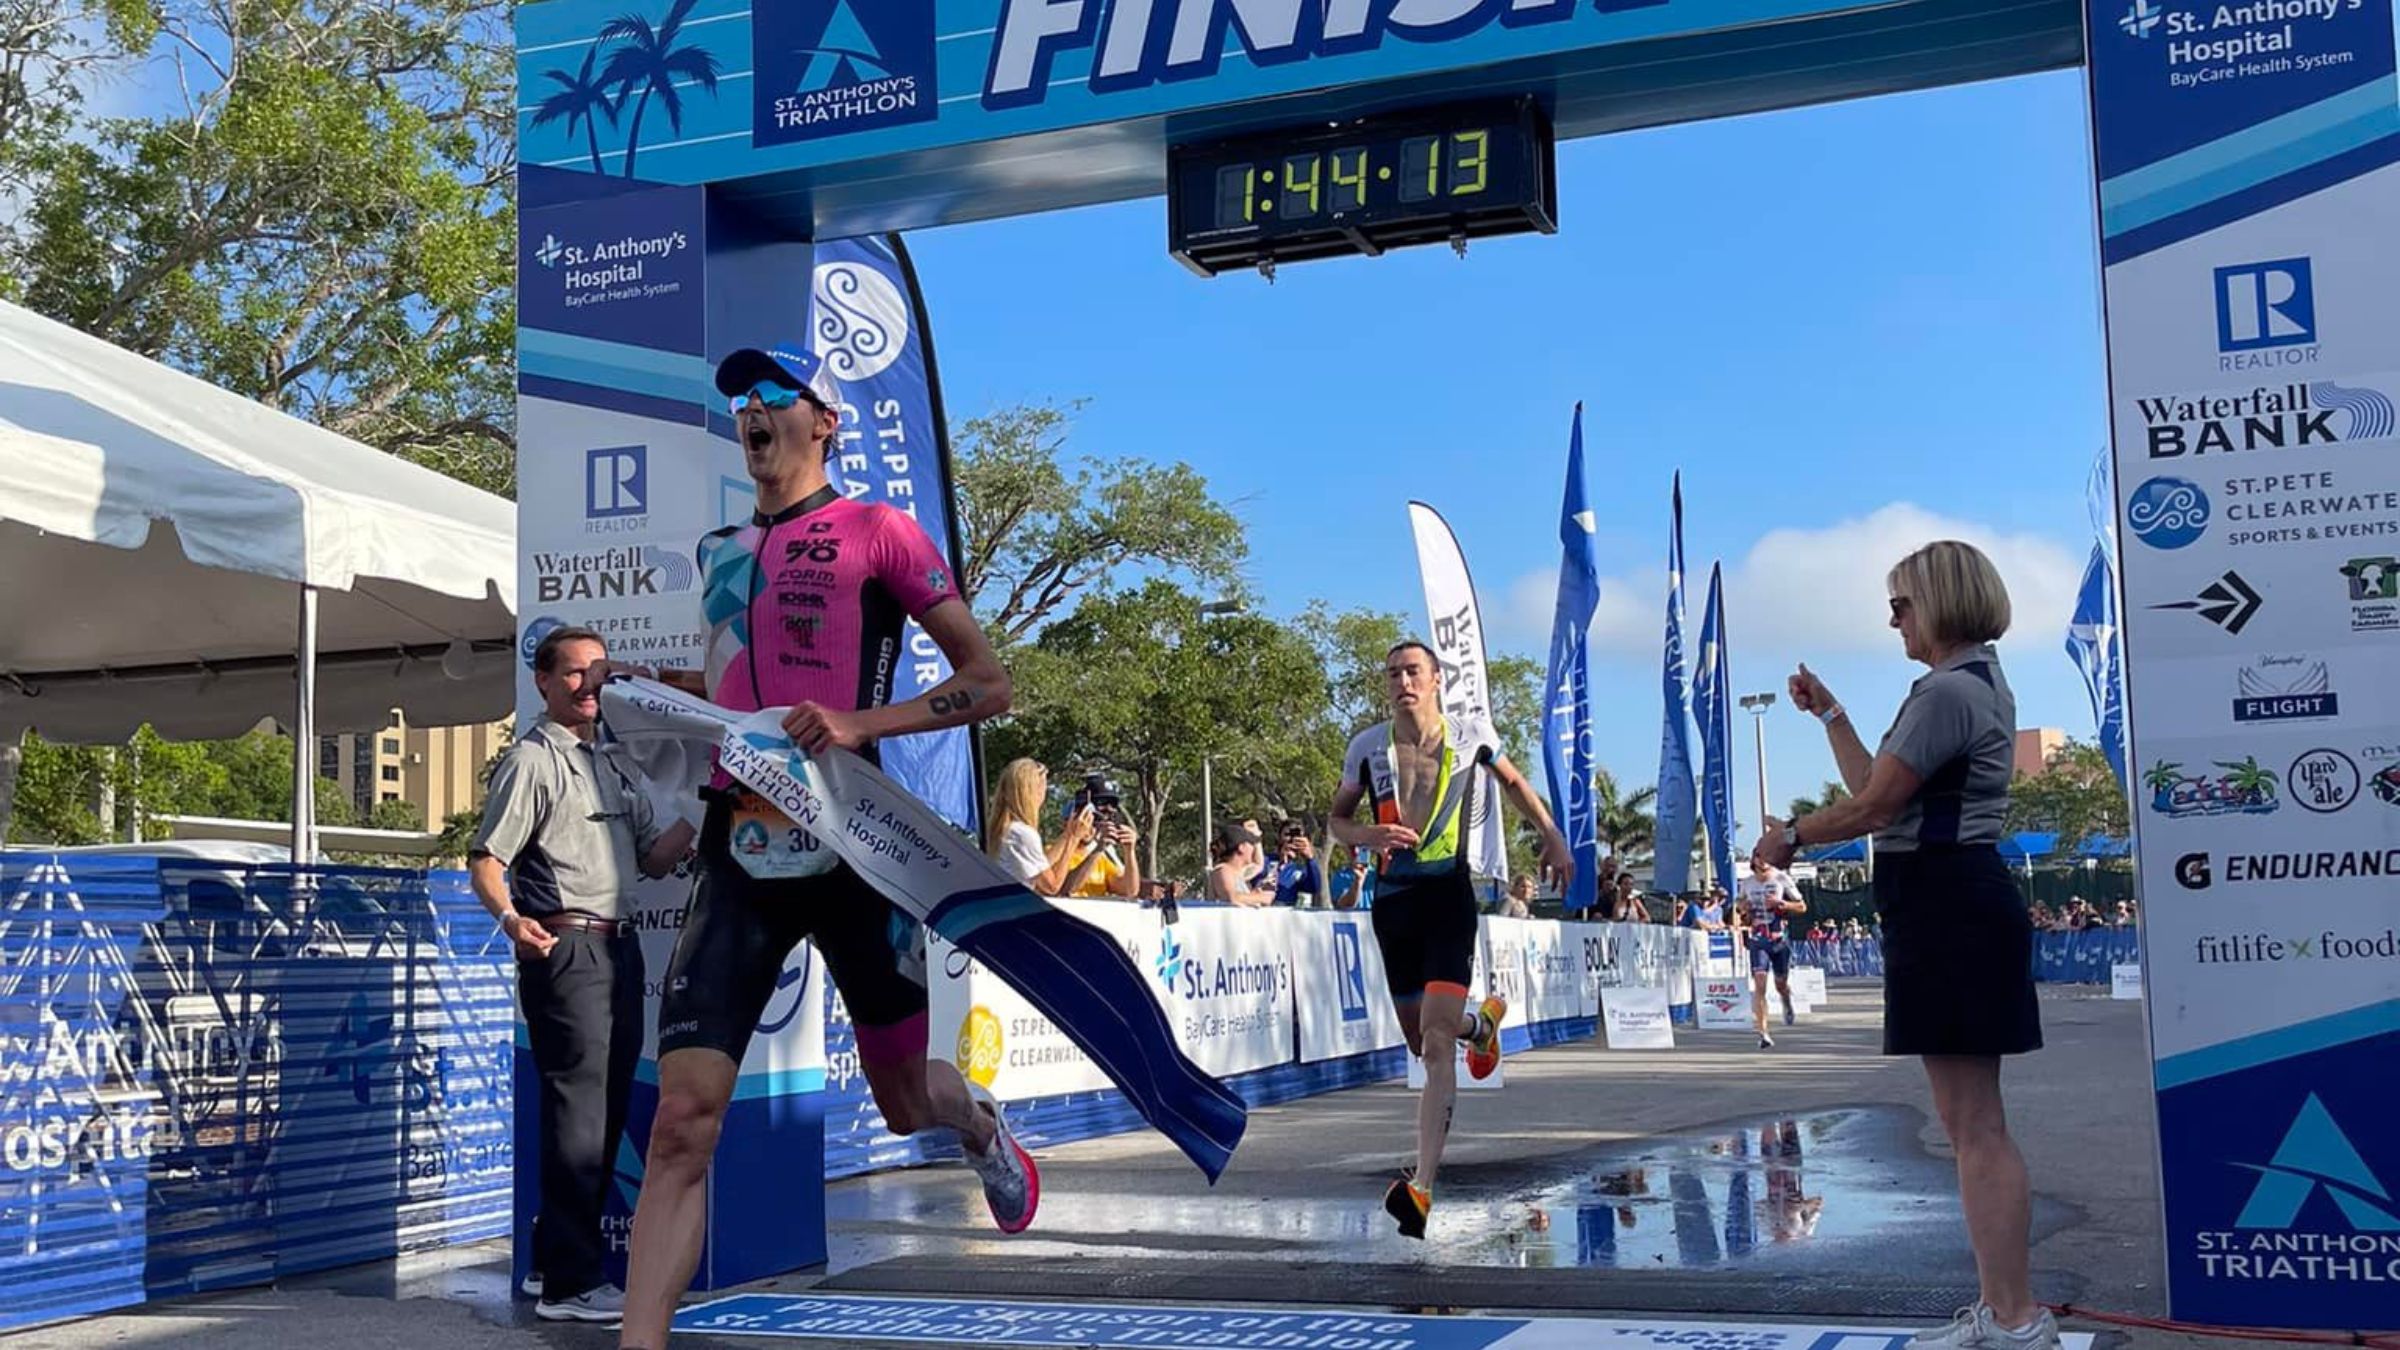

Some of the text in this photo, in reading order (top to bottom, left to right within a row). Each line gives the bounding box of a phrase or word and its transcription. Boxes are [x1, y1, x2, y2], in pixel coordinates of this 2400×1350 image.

[2166, 0, 2362, 35] St. Anthonys
[2169, 25, 2292, 65] Hospital
[2170, 51, 2354, 87] BayCare Health System
[774, 75, 916, 111] ST. ANTHONY'S
[774, 91, 916, 129] TRIATHLON
[565, 232, 687, 266] St. Anthony's
[565, 260, 643, 290] Hospital
[607, 286, 642, 300] Health
[643, 281, 680, 297] System
[2137, 383, 2309, 426] Waterfall
[2148, 410, 2339, 459] BANK
[2225, 472, 2333, 496] ST.PETE
[2227, 493, 2399, 521] CLEARWATE
[2228, 521, 2398, 546] SPORTS & EVENTS
[534, 546, 641, 575] Waterfall
[538, 567, 658, 602] BANK
[607, 633, 703, 652] EARWATER
[1456, 604, 1484, 717] Waterf
[2246, 698, 2323, 716] FLIGHT
[721, 745, 819, 825] RIATHLON
[788, 827, 820, 853] 30
[846, 817, 911, 866] Hospital
[855, 798, 951, 869] St. Anthony's
[2195, 934, 2285, 963] fitlife
[1184, 953, 1287, 1002] St. Anthony's
[1011, 1018, 1062, 1038] ST.PET
[2196, 1231, 2400, 1254] ST. ANTHON
[2198, 1253, 2400, 1281] TRIATHLO
[775, 1299, 1415, 1335] Proud Sponsor of the
[1111, 1327, 1416, 1350] Triathlon
